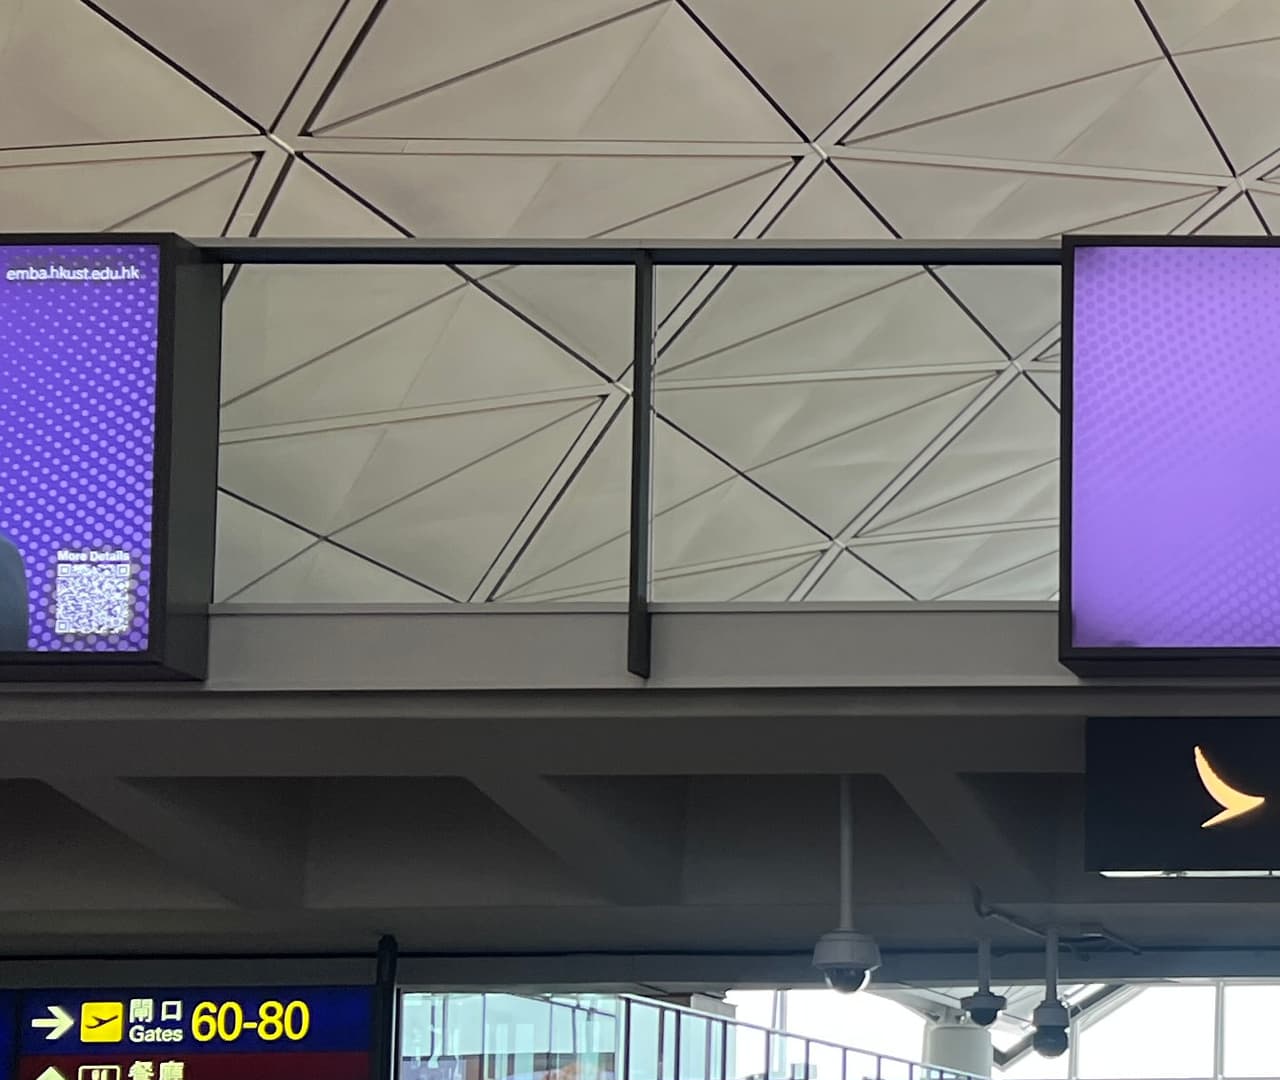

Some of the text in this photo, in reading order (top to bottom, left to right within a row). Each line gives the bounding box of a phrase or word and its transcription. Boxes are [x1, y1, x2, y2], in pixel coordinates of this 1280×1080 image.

[6, 265, 140, 281] emba.hkust.edu.hk
[57, 550, 130, 562] More Details
[129, 998, 182, 1023] 閘口
[129, 1000, 310, 1042] Gates 60-80
